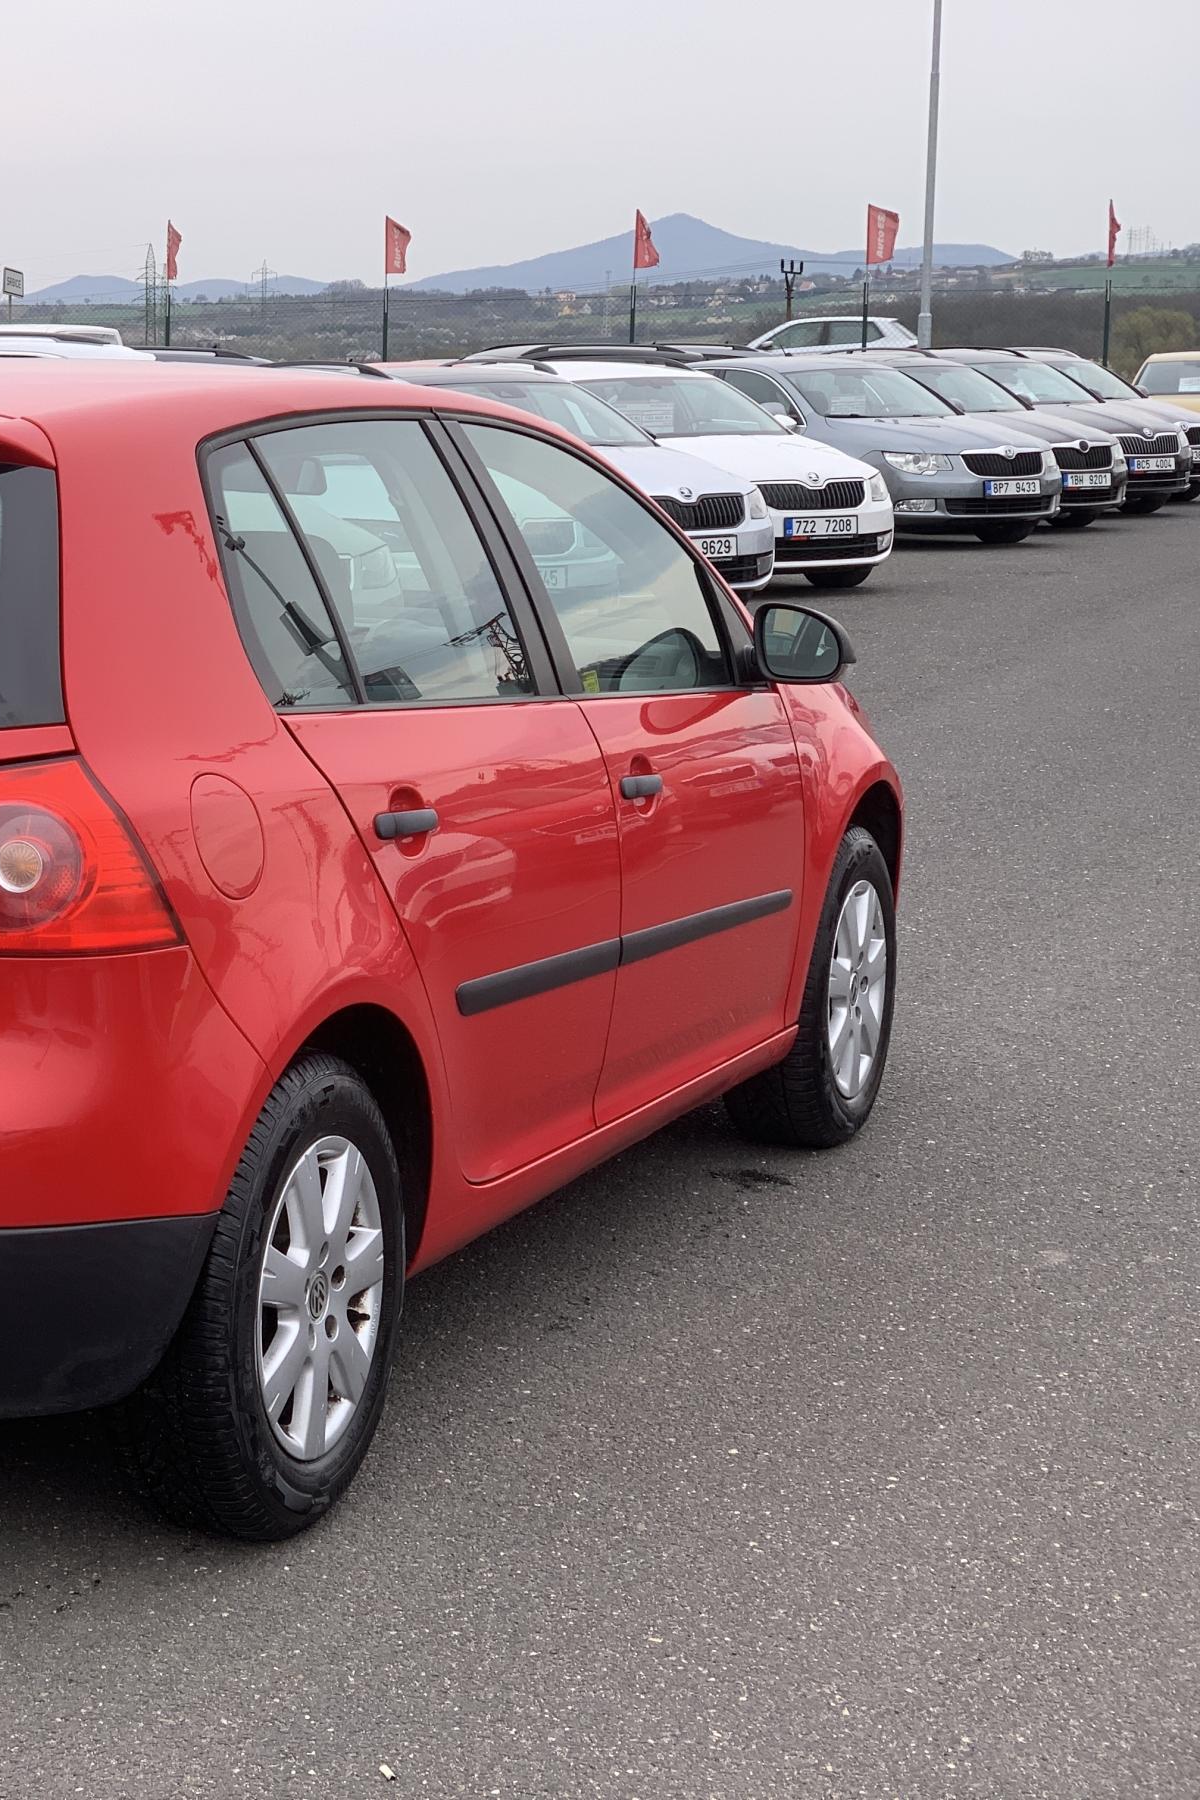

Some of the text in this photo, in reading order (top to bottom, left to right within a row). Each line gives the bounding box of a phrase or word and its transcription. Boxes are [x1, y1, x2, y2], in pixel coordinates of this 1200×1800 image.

[1089, 474, 1108, 485] 9201
[993, 481, 1037, 494] 8P7 9433
[795, 519, 817, 534] 7Z2
[825, 518, 852, 534] 7208
[701, 539, 732, 555] 9629
